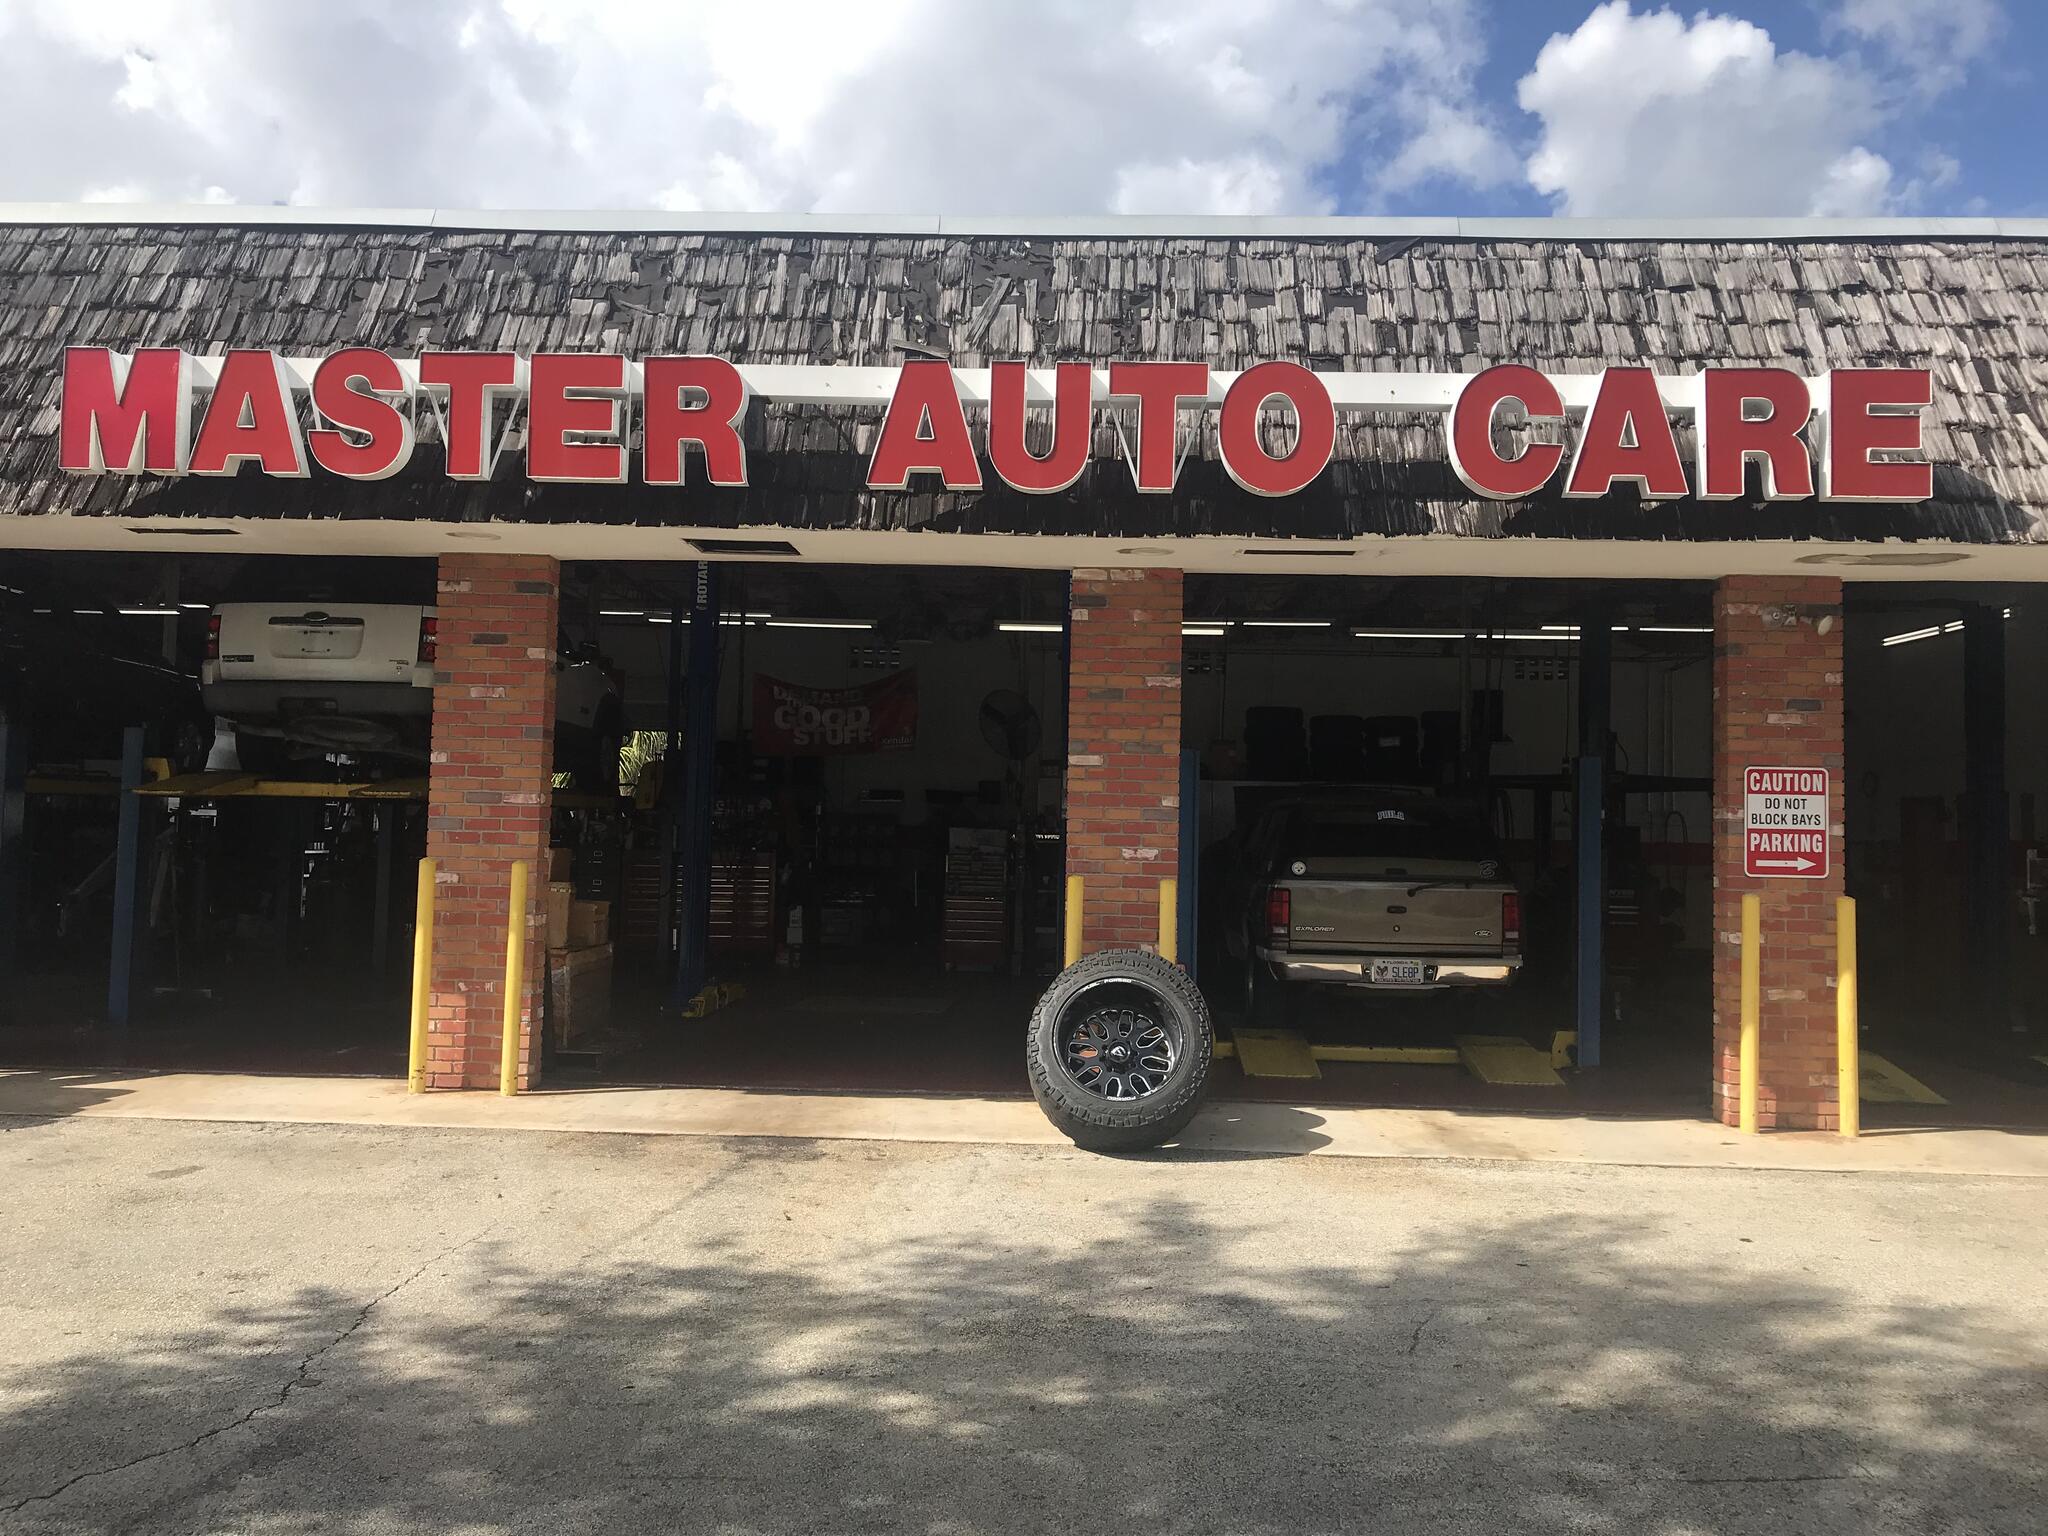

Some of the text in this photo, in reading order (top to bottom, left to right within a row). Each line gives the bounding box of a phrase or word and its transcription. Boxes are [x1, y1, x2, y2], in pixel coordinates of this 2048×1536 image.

[59, 347, 1934, 501] MASTER AUTO CARE
[774, 704, 871, 731] GOOD
[793, 724, 873, 745] STUFF
[1749, 772, 1823, 792] CAUTION
[1765, 798, 1807, 809] DO NOT
[1751, 813, 1821, 825] BLOCK BAYS
[1750, 832, 1823, 853] PARKING
[1391, 966, 1419, 978] SLE8P
